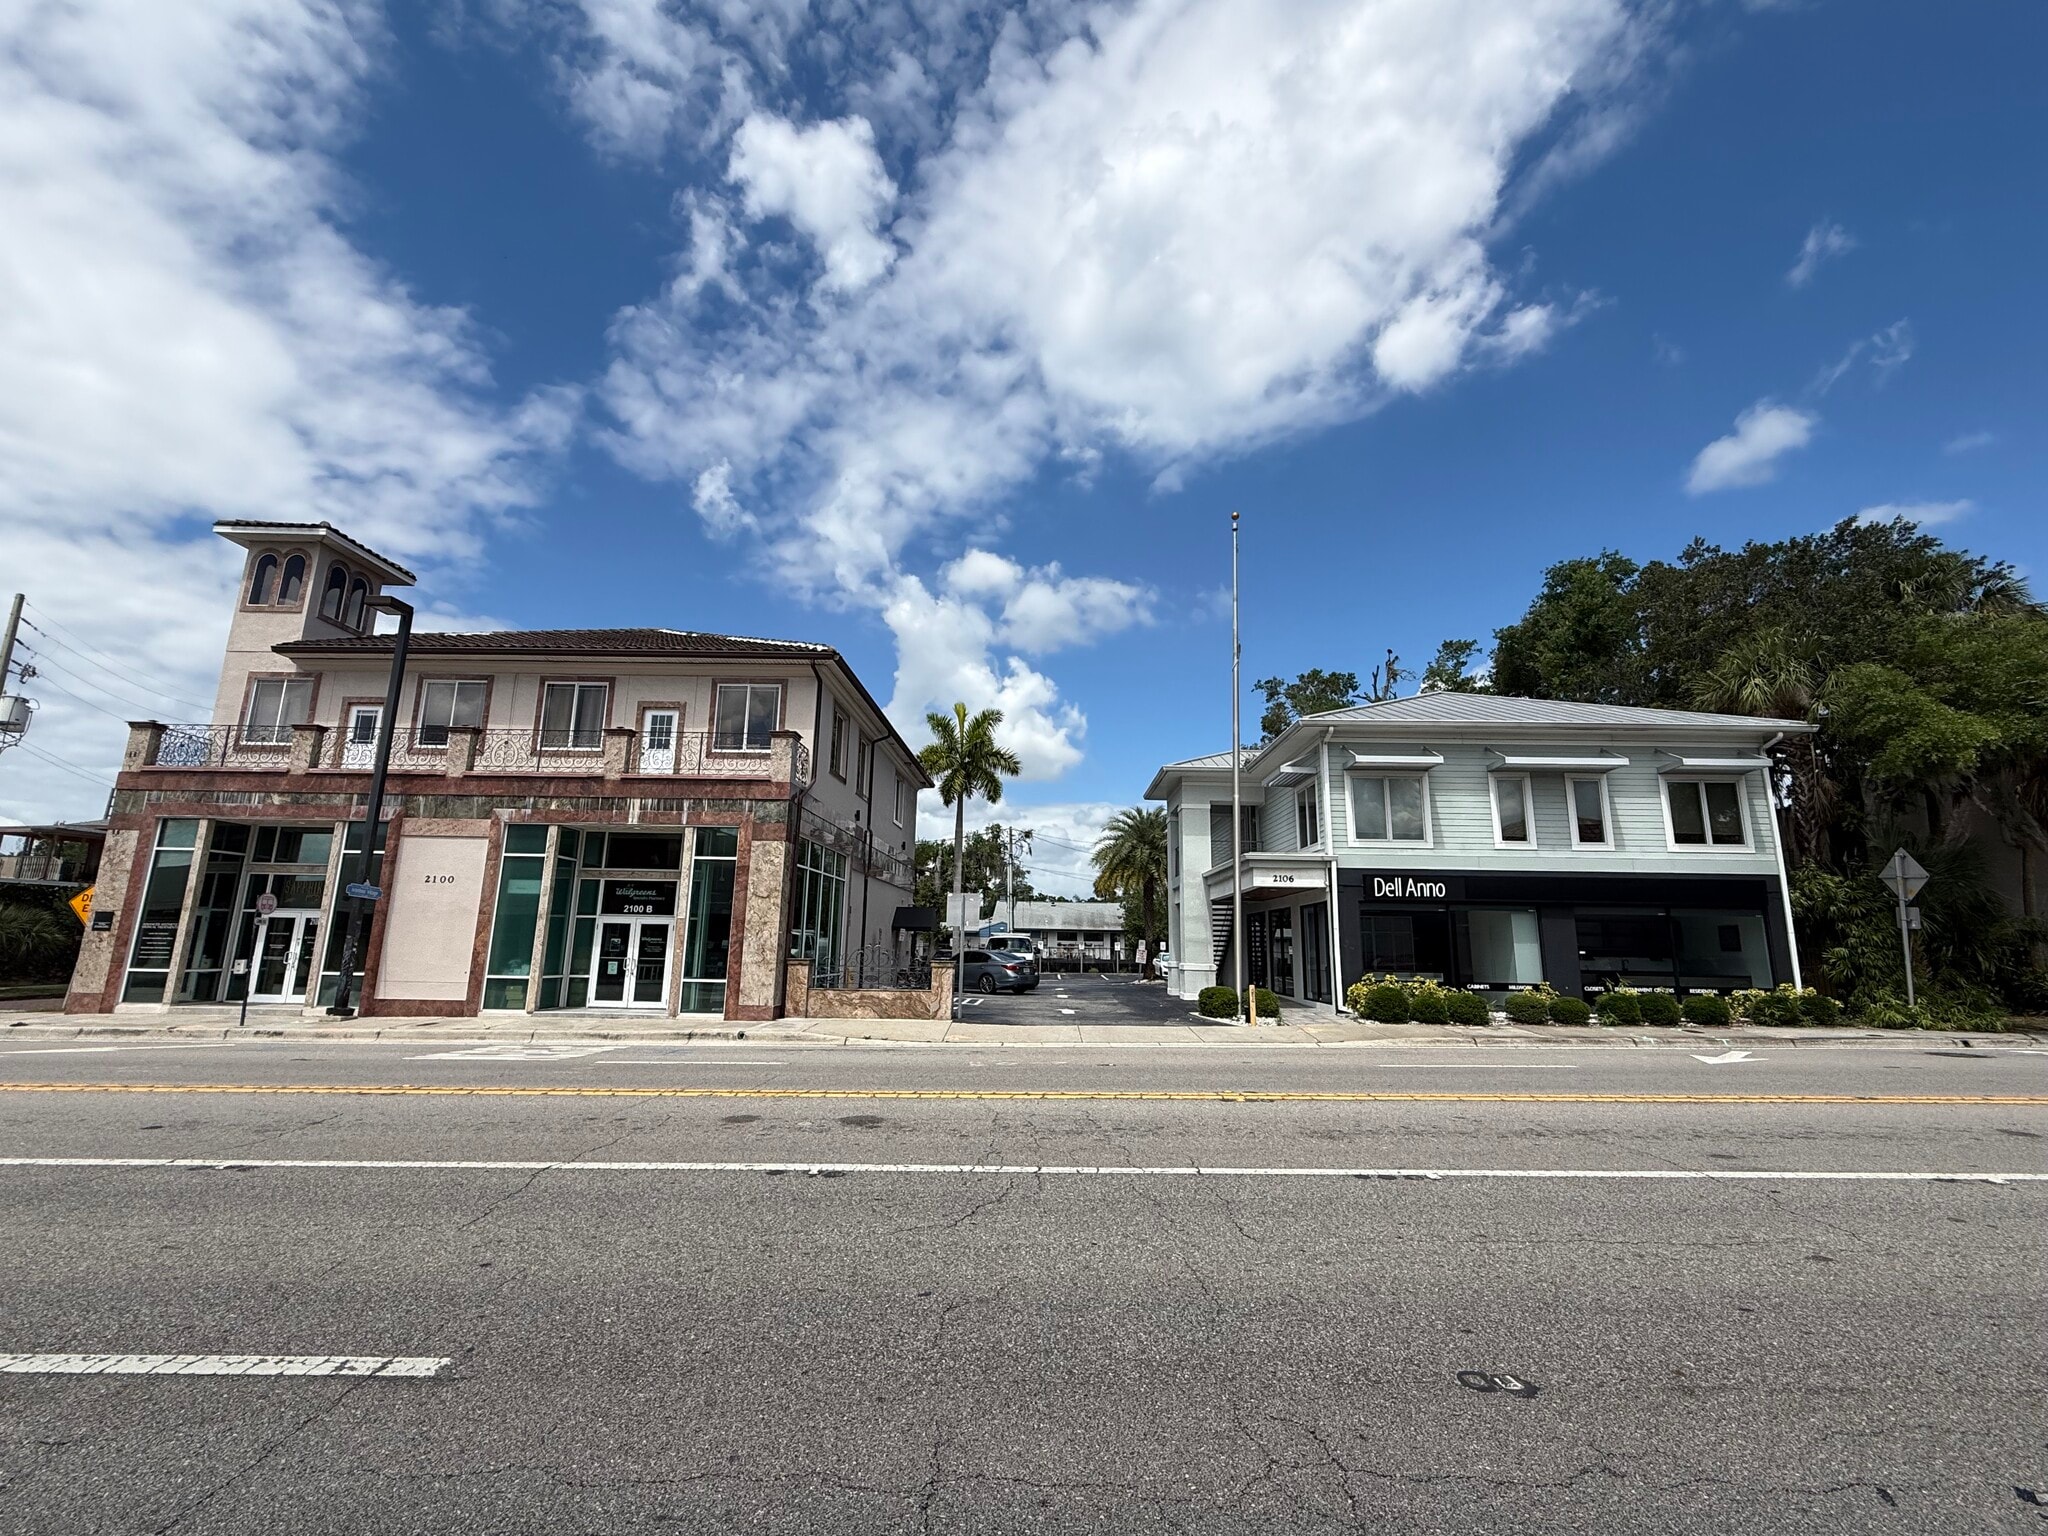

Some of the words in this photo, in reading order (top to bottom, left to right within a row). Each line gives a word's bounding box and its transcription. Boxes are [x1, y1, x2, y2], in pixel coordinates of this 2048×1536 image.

[424, 875, 455, 884] 2100
[1272, 874, 1295, 883] 2106
[1373, 877, 1402, 897] Dell
[1405, 878, 1446, 898] Anno
[615, 888, 657, 898] Walgreens
[623, 905, 644, 913] 2100
[646, 905, 653, 913] B
